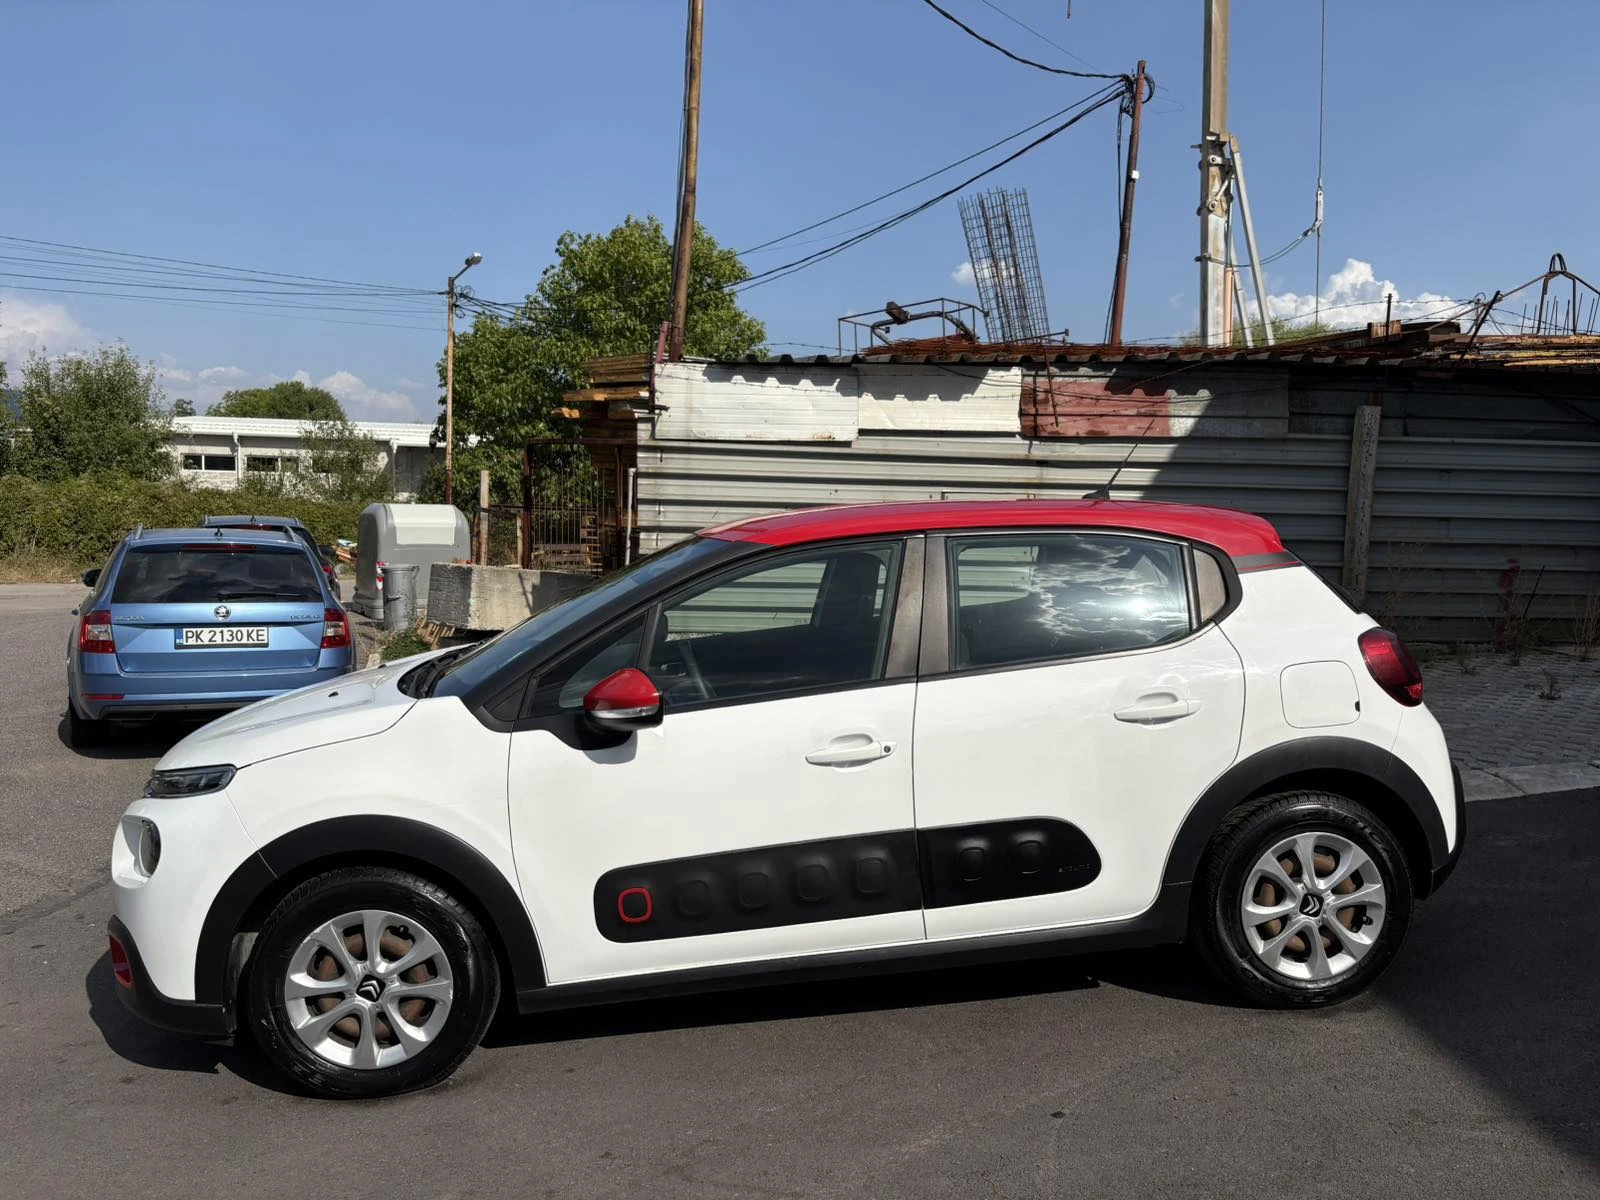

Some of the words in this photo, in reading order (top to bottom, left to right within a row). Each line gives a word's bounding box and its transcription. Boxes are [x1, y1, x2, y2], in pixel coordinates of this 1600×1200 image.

[185, 630, 205, 643] PK
[208, 629, 244, 643] 2130
[246, 629, 266, 642] KE
